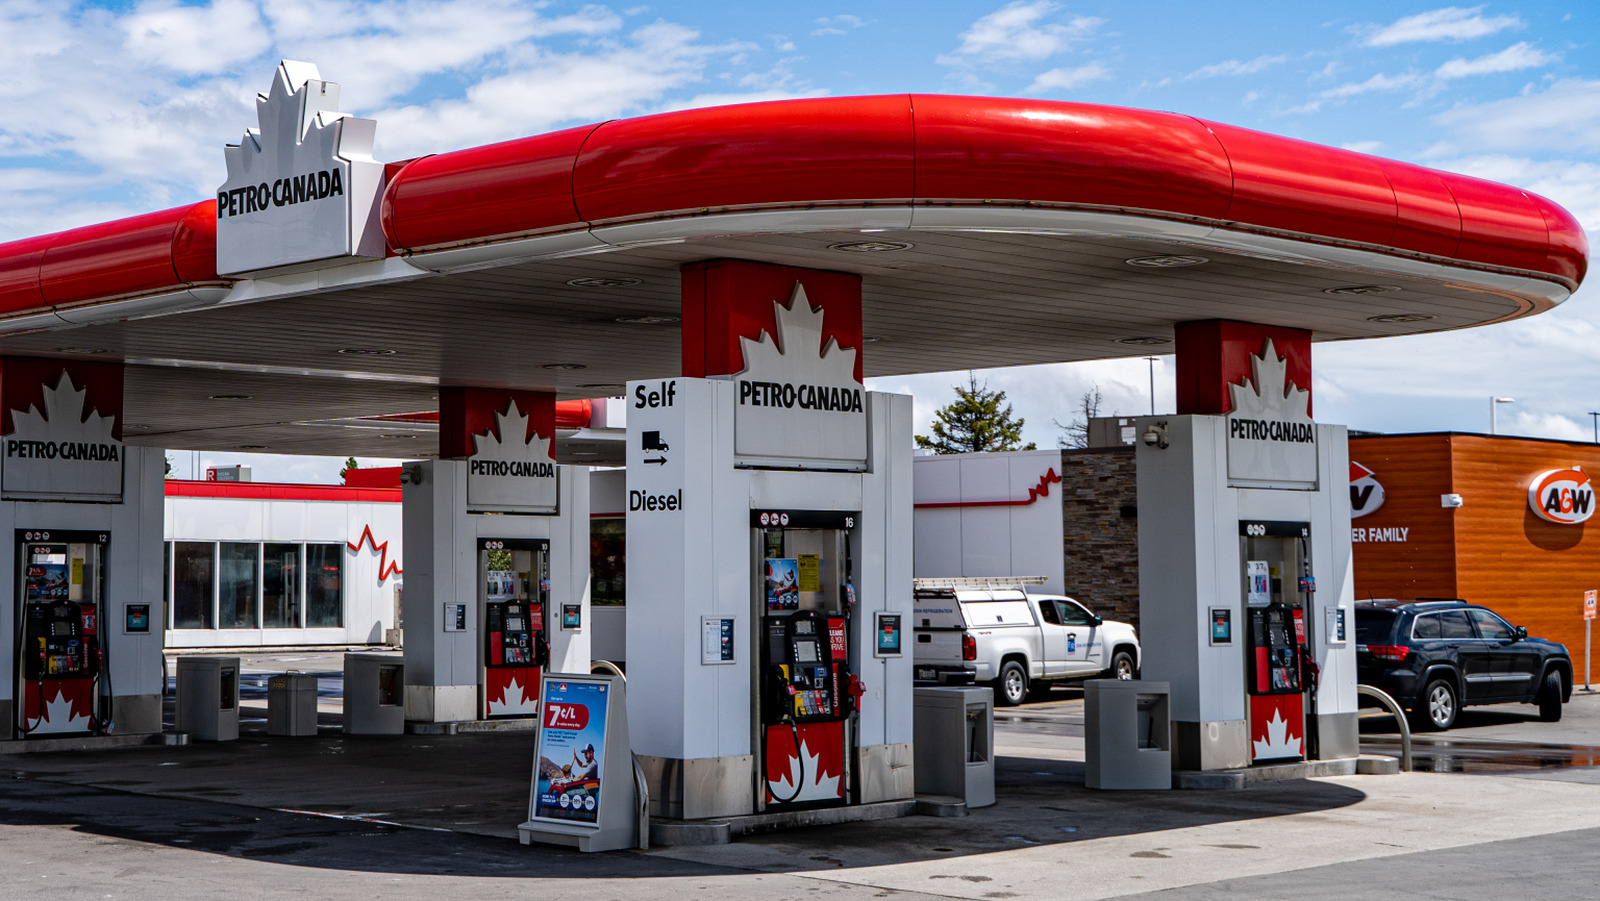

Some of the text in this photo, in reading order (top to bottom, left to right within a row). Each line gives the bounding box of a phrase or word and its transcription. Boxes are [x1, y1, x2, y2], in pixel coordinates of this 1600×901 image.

[635, 380, 676, 408] Self
[630, 488, 682, 512] Diesel
[1544, 488, 1592, 514] A&W
[845, 516, 854, 528] 16
[99, 534, 106, 542] 12
[1302, 528, 1308, 537] 14
[1352, 528, 1409, 542] ER FAMILY
